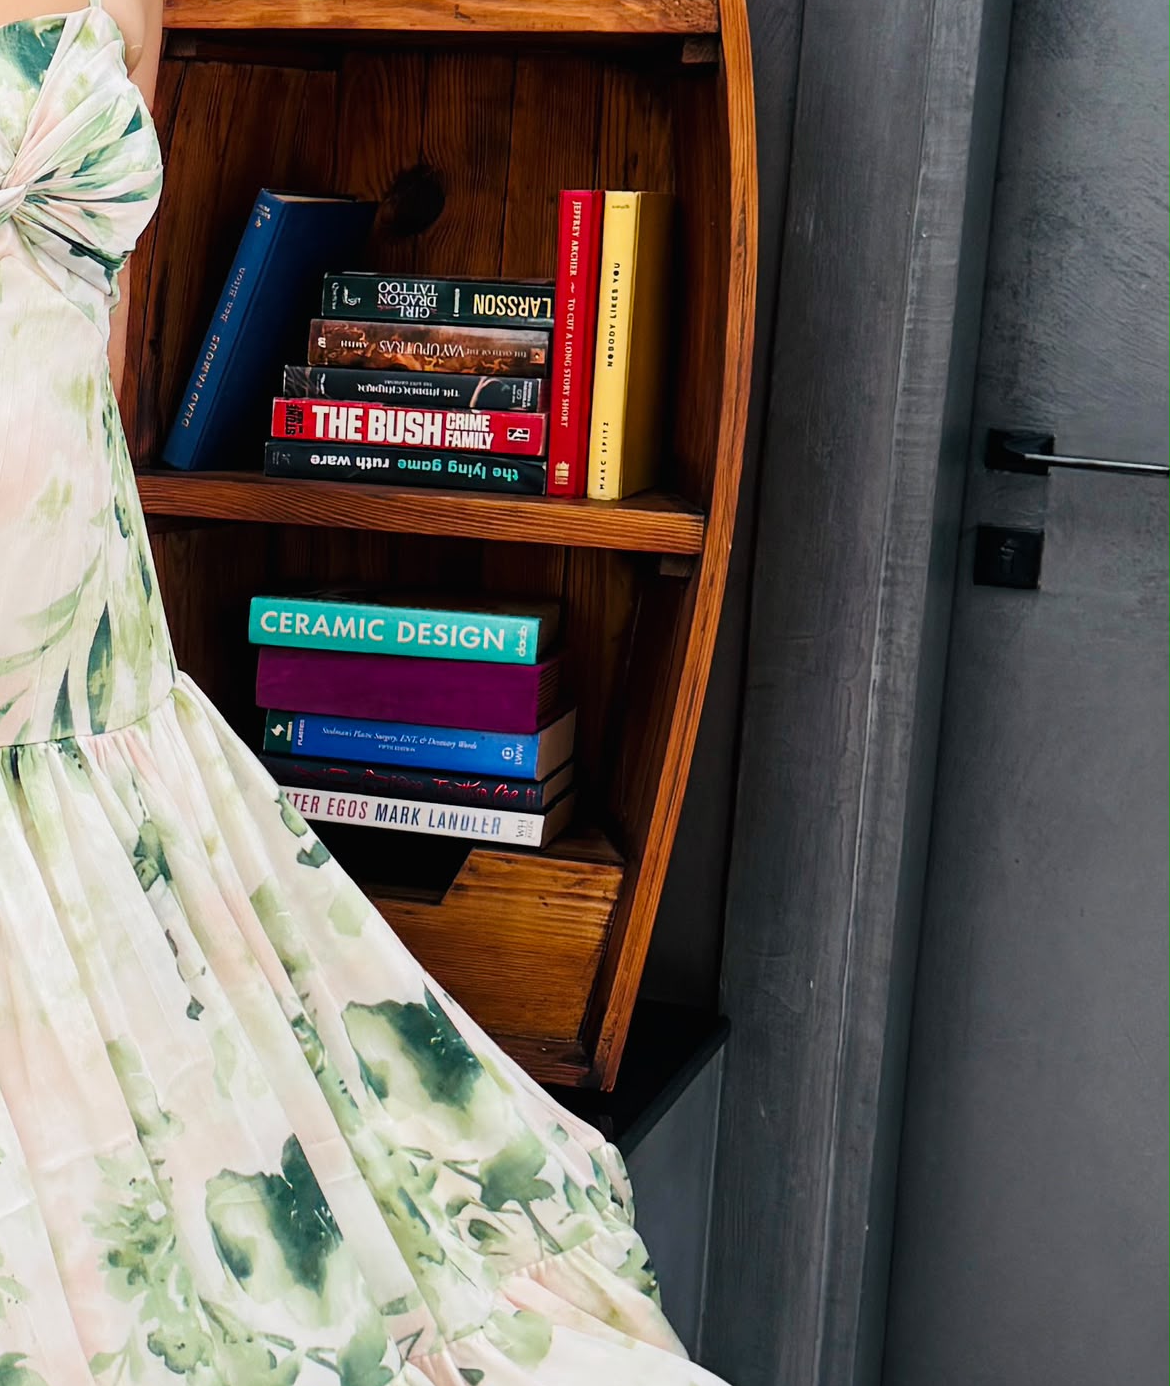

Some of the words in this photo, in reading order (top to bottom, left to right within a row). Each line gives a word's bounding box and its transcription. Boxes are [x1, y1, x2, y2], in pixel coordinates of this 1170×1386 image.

[572, 201, 582, 237] JEFFREY
[570, 239, 580, 277] ARCHER
[612, 262, 621, 283] YOU
[378, 281, 438, 295] TATTOO
[220, 301, 234, 323] Ben
[377, 295, 438, 308] DRAGON
[398, 305, 430, 318] GIRL
[473, 293, 552, 319] LARSSON
[567, 298, 576, 311] TO
[609, 288, 619, 319] LIKES
[566, 313, 574, 332] CUT
[565, 332, 574, 340] A
[607, 324, 616, 367] NOBODY
[380, 339, 465, 358] VAYUPUTRAS
[563, 341, 573, 367] LONG
[182, 392, 199, 427] DEAD
[196, 335, 220, 388] FAMOUS
[562, 368, 572, 397] STORY
[446, 412, 491, 432] CRIME
[560, 398, 570, 428] SHORT
[312, 405, 365, 441] THE
[367, 408, 443, 447] BUSH
[444, 430, 494, 450] FAMILY
[310, 454, 351, 467] ware
[356, 455, 390, 469] ruth
[397, 459, 442, 473] game
[448, 460, 486, 480] lying
[492, 467, 520, 481] the
[260, 611, 385, 641] CERAMIC
[396, 621, 506, 651] DESIGN
[514, 743, 524, 765] LWW
[286, 793, 320, 814] TER
[326, 797, 368, 820] EGOS
[374, 803, 421, 827] MARK
